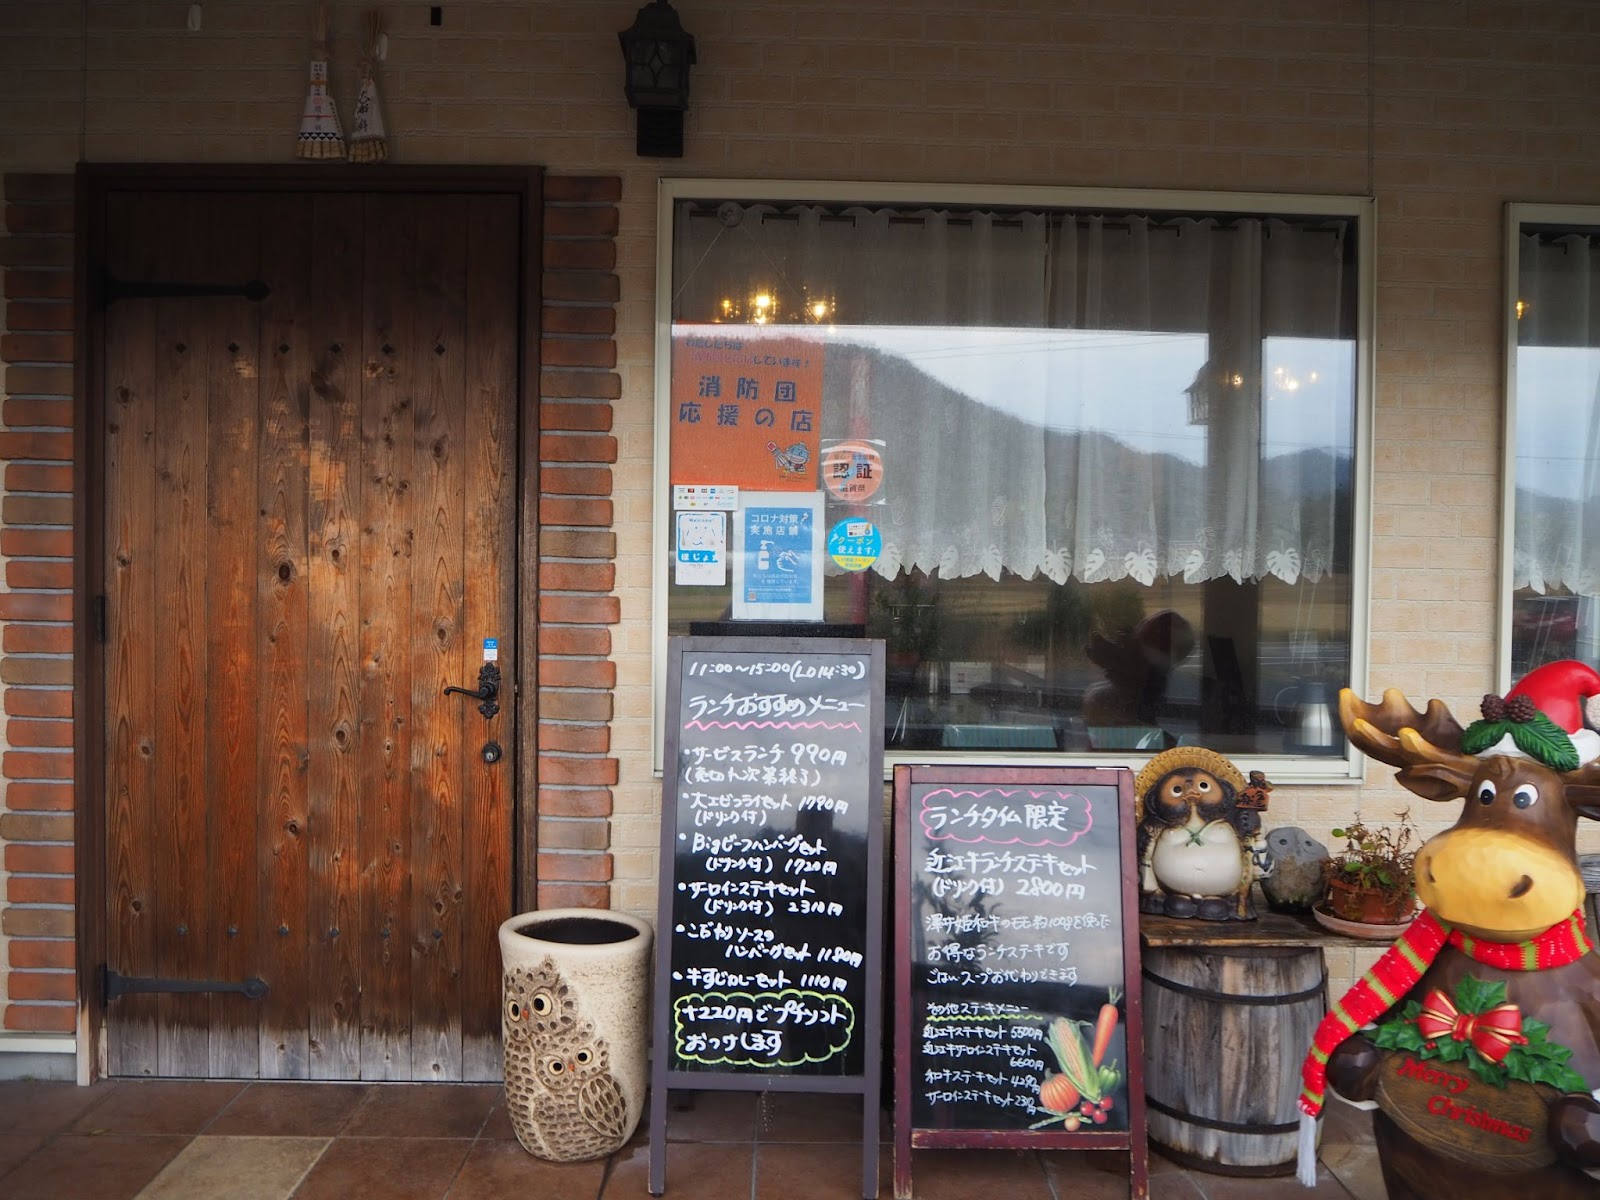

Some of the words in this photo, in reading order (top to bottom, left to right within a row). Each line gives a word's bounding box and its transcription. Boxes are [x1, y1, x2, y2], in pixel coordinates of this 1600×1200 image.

[699, 375, 796, 402] 消防団
[679, 402, 813, 432] 応援の店
[833, 463, 873, 479] 認証
[751, 513, 798, 524] コロナ対策
[750, 525, 799, 536] 実施店舗
[837, 536, 874, 546] クーポン
[1015, 877, 1085, 900] 2800円
[1397, 1057, 1469, 1094] Merry
[1427, 1095, 1532, 1144] Christmas
